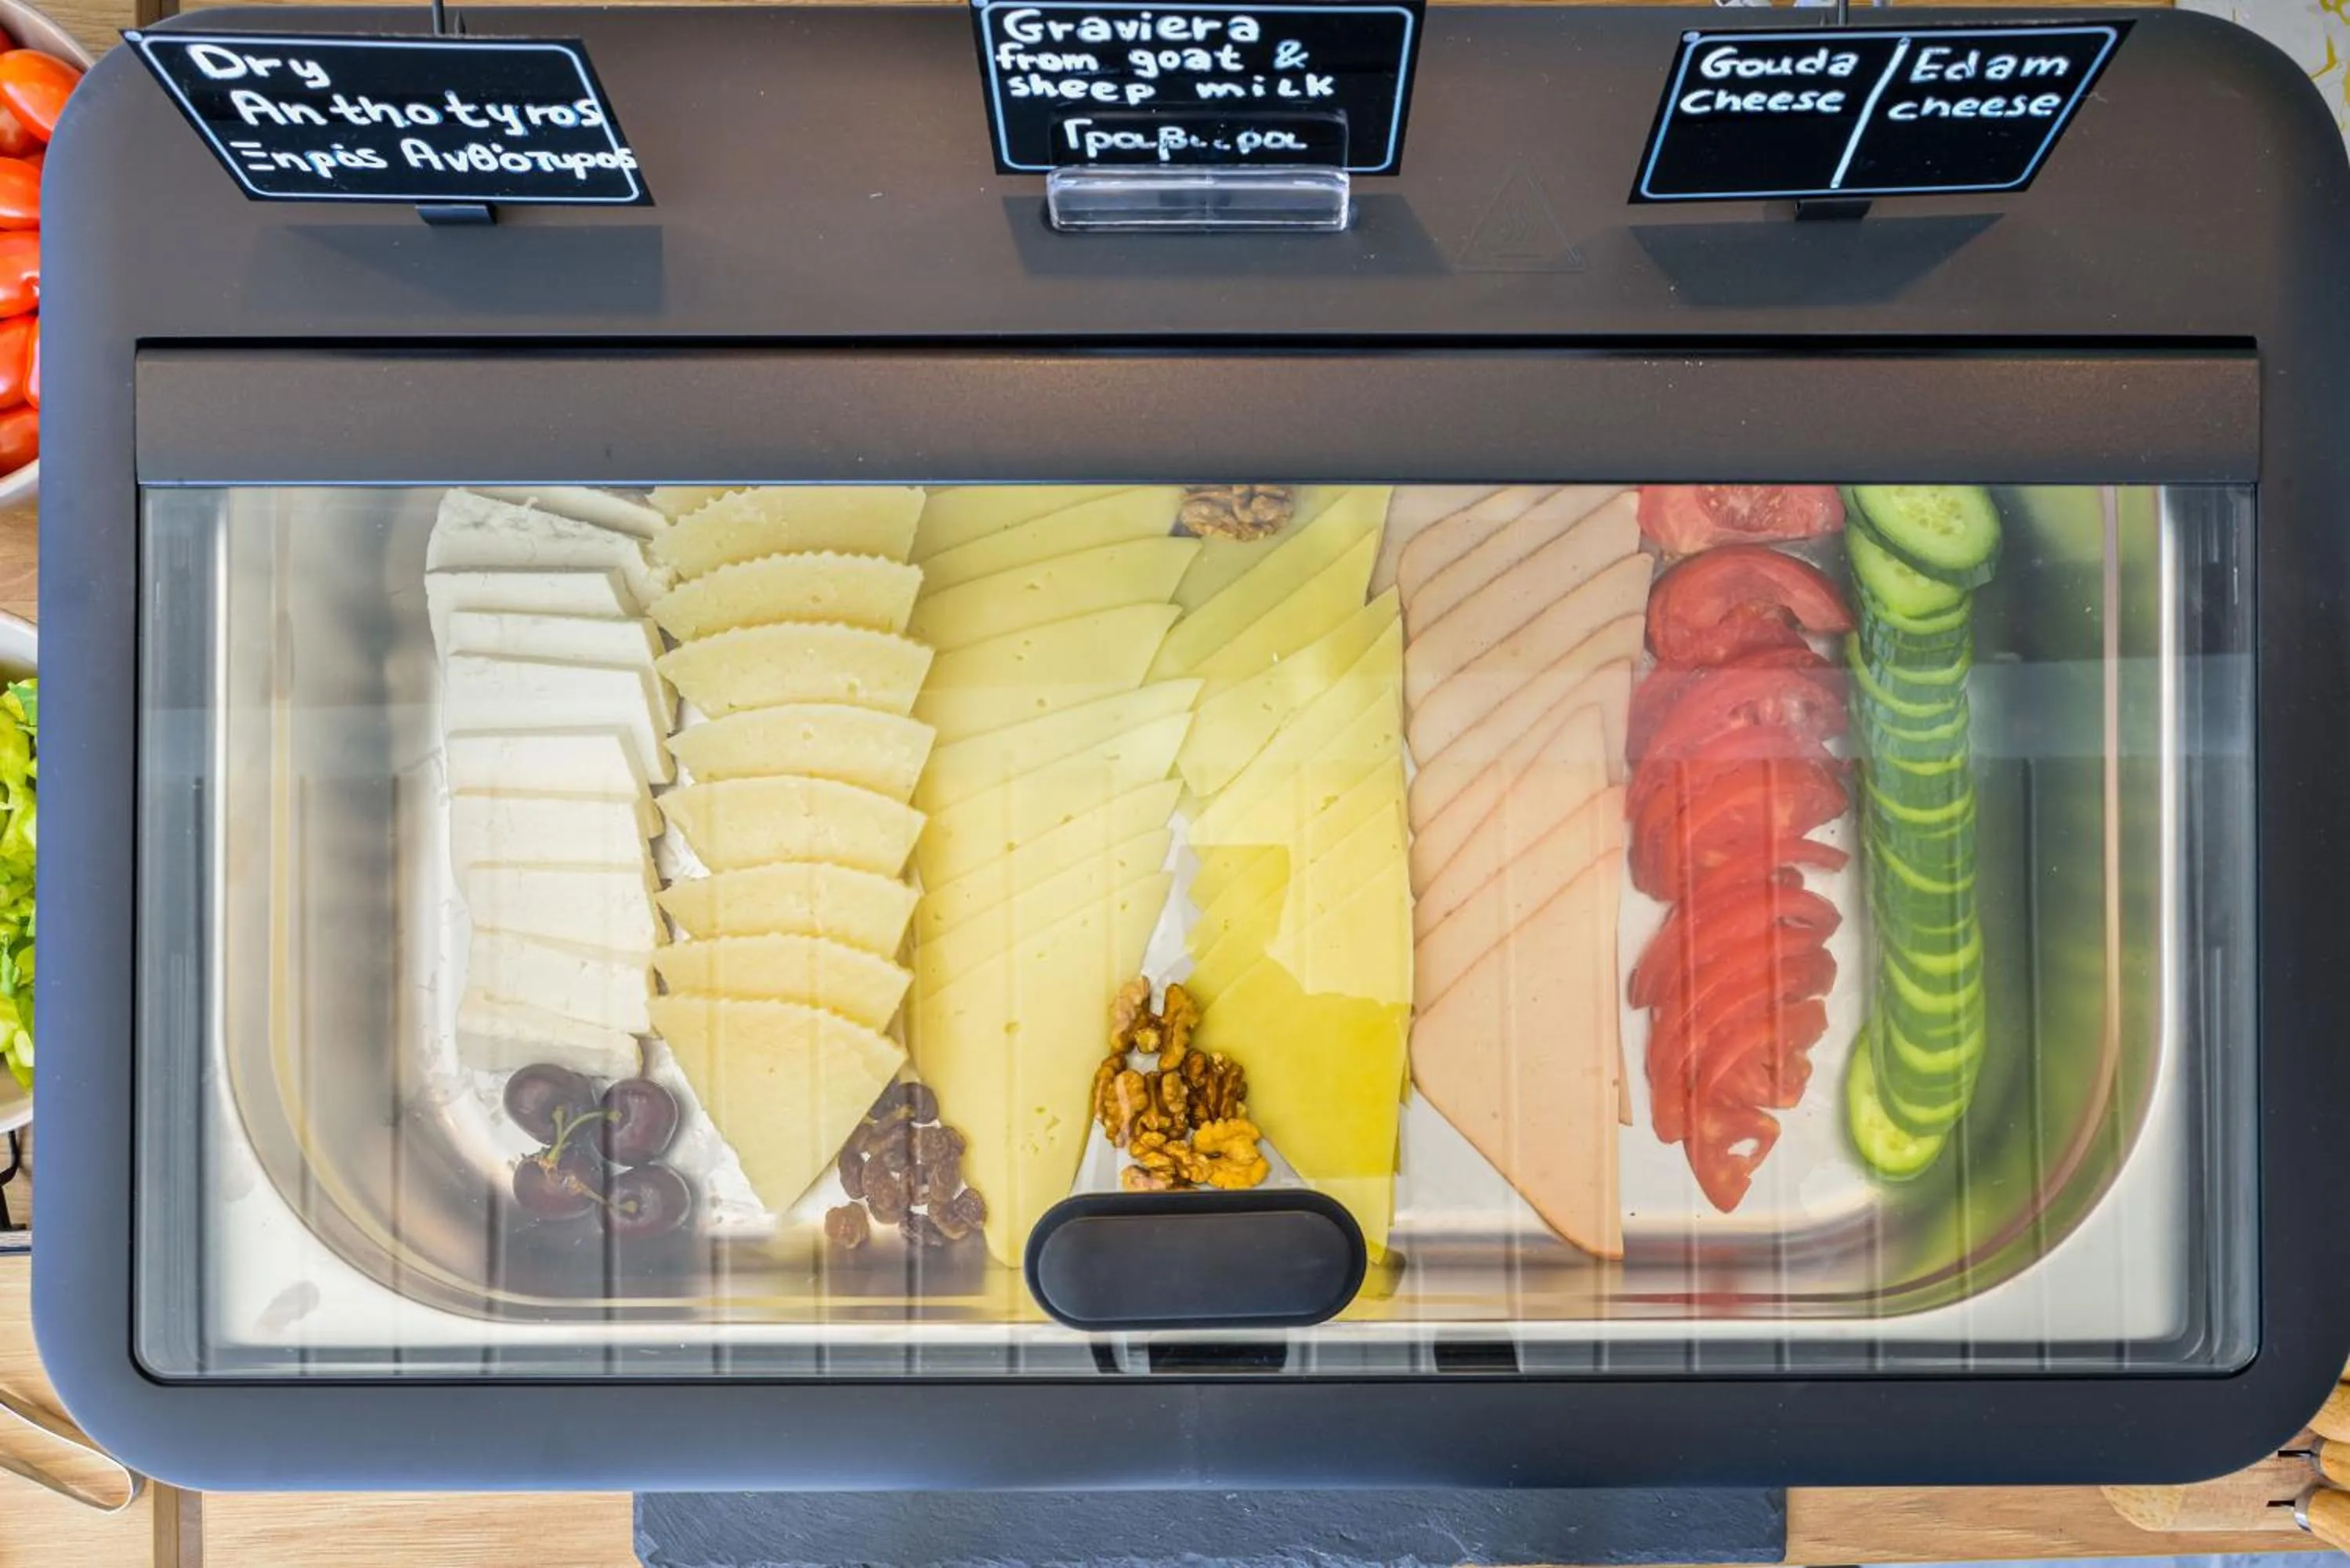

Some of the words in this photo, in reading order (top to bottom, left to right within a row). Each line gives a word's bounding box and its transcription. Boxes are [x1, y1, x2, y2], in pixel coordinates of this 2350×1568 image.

[1003, 9, 1260, 42] Graviera
[186, 44, 330, 88] Dry
[996, 42, 1098, 71] from
[1129, 44, 1244, 78] goat
[1274, 40, 1309, 69] &
[1700, 46, 1859, 78] Gouda
[1911, 47, 2070, 82] Edam
[1009, 74, 1156, 105] sheep
